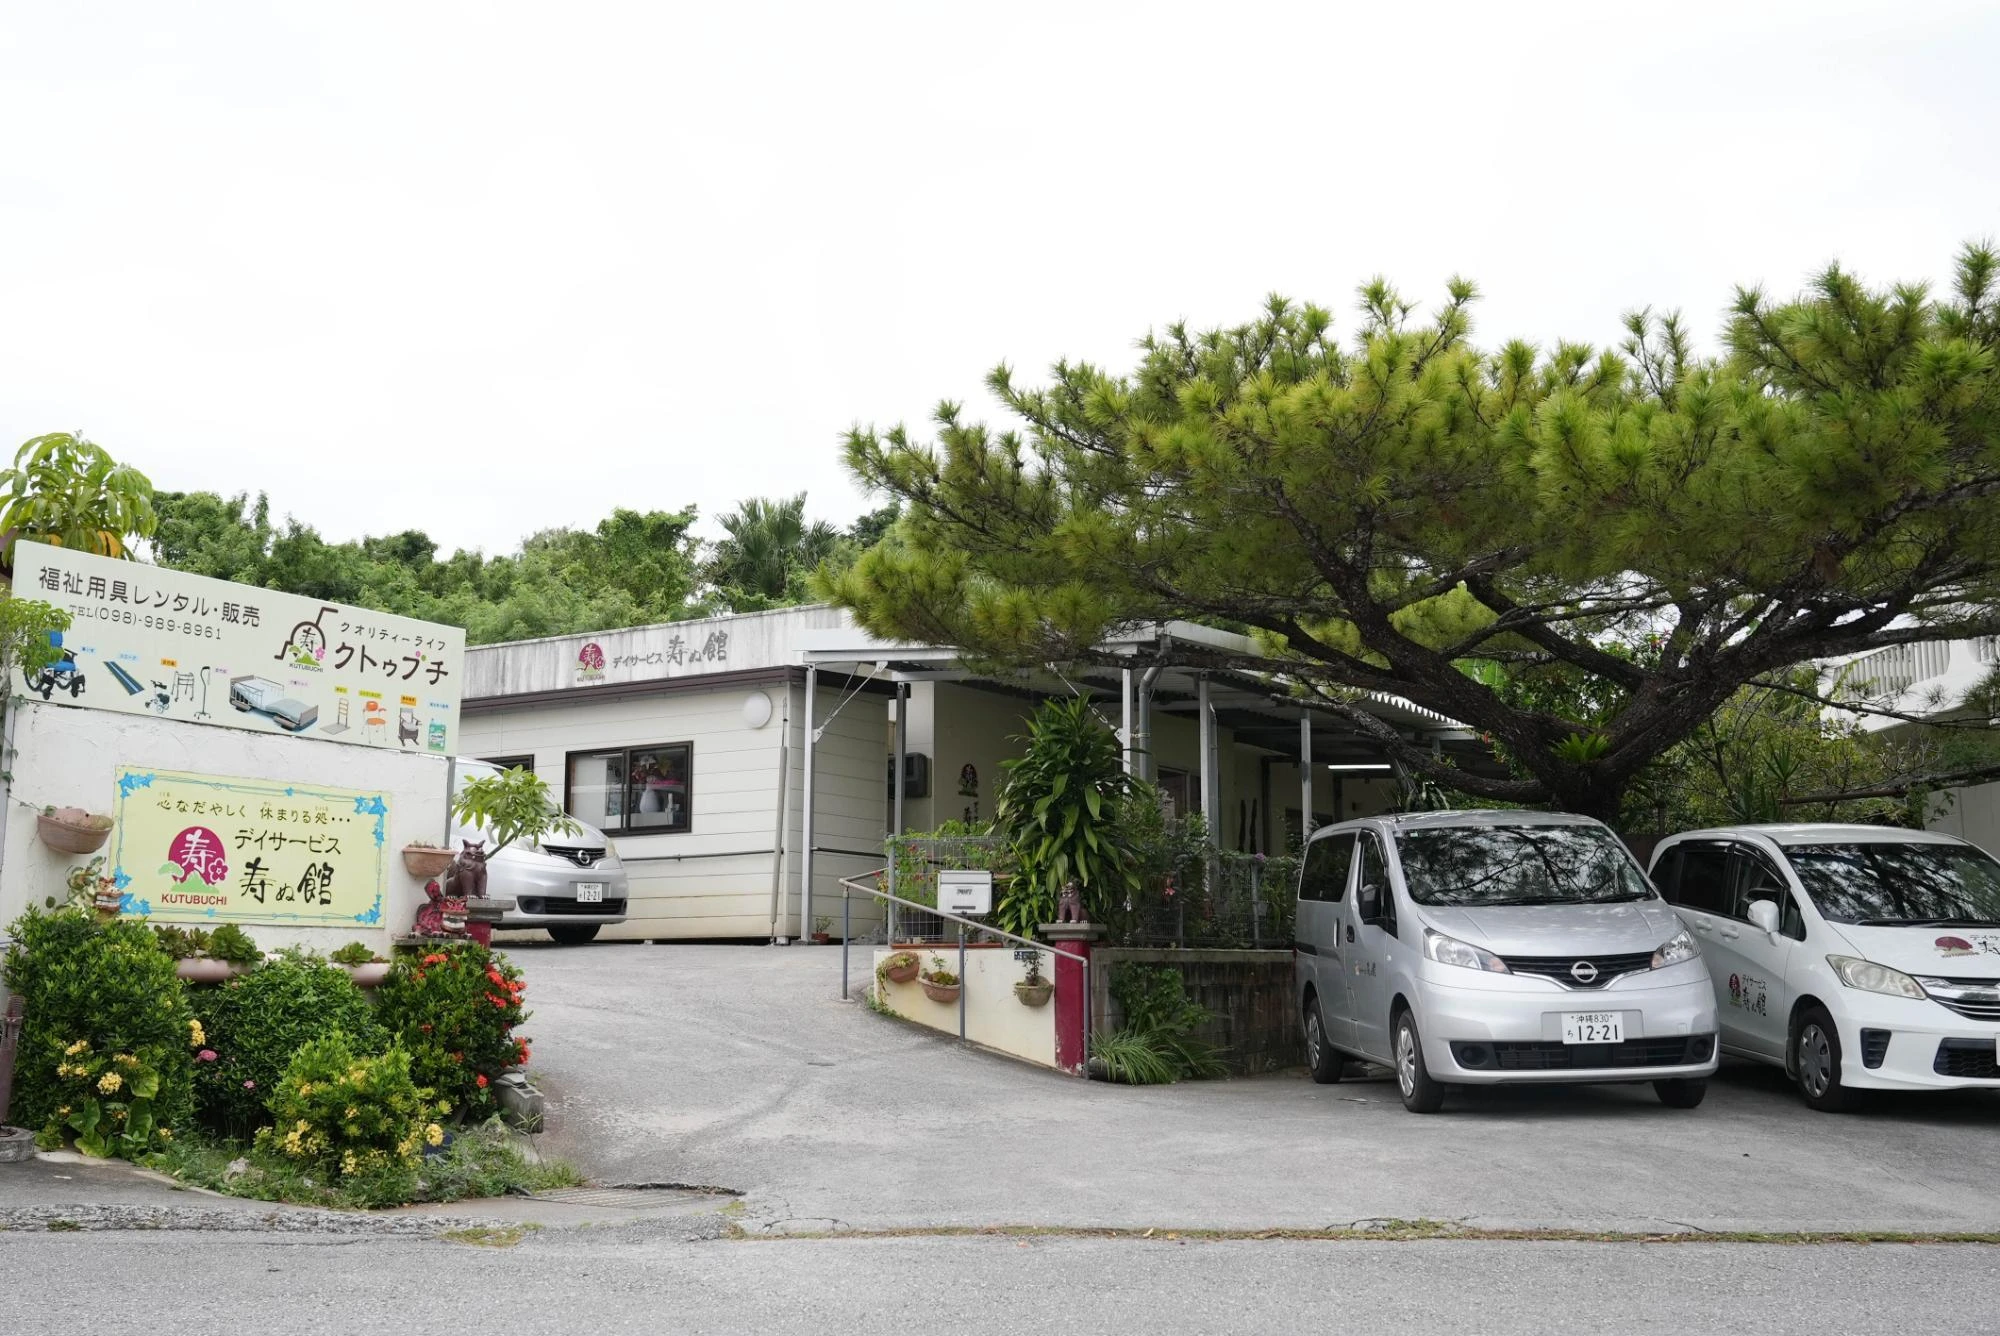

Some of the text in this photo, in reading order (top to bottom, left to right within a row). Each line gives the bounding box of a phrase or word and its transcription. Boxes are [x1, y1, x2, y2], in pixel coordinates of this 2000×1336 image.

[39, 566, 260, 627] 福祉用具レンタル・販売
[69, 604, 221, 640] TEL(098)-989-8961
[341, 622, 446, 651] クオリティーライフ
[289, 663, 324, 673] KUTUBUCHI
[335, 642, 448, 685] クトゥブチ
[612, 651, 664, 669] デイサービス
[157, 799, 245, 818] 心なだやしく
[235, 828, 341, 855] デイサービス
[239, 857, 334, 905] 寿ぬ館
[161, 893, 227, 906] KUTUBUCHI
[1578, 1024, 1618, 1042] 12-21
